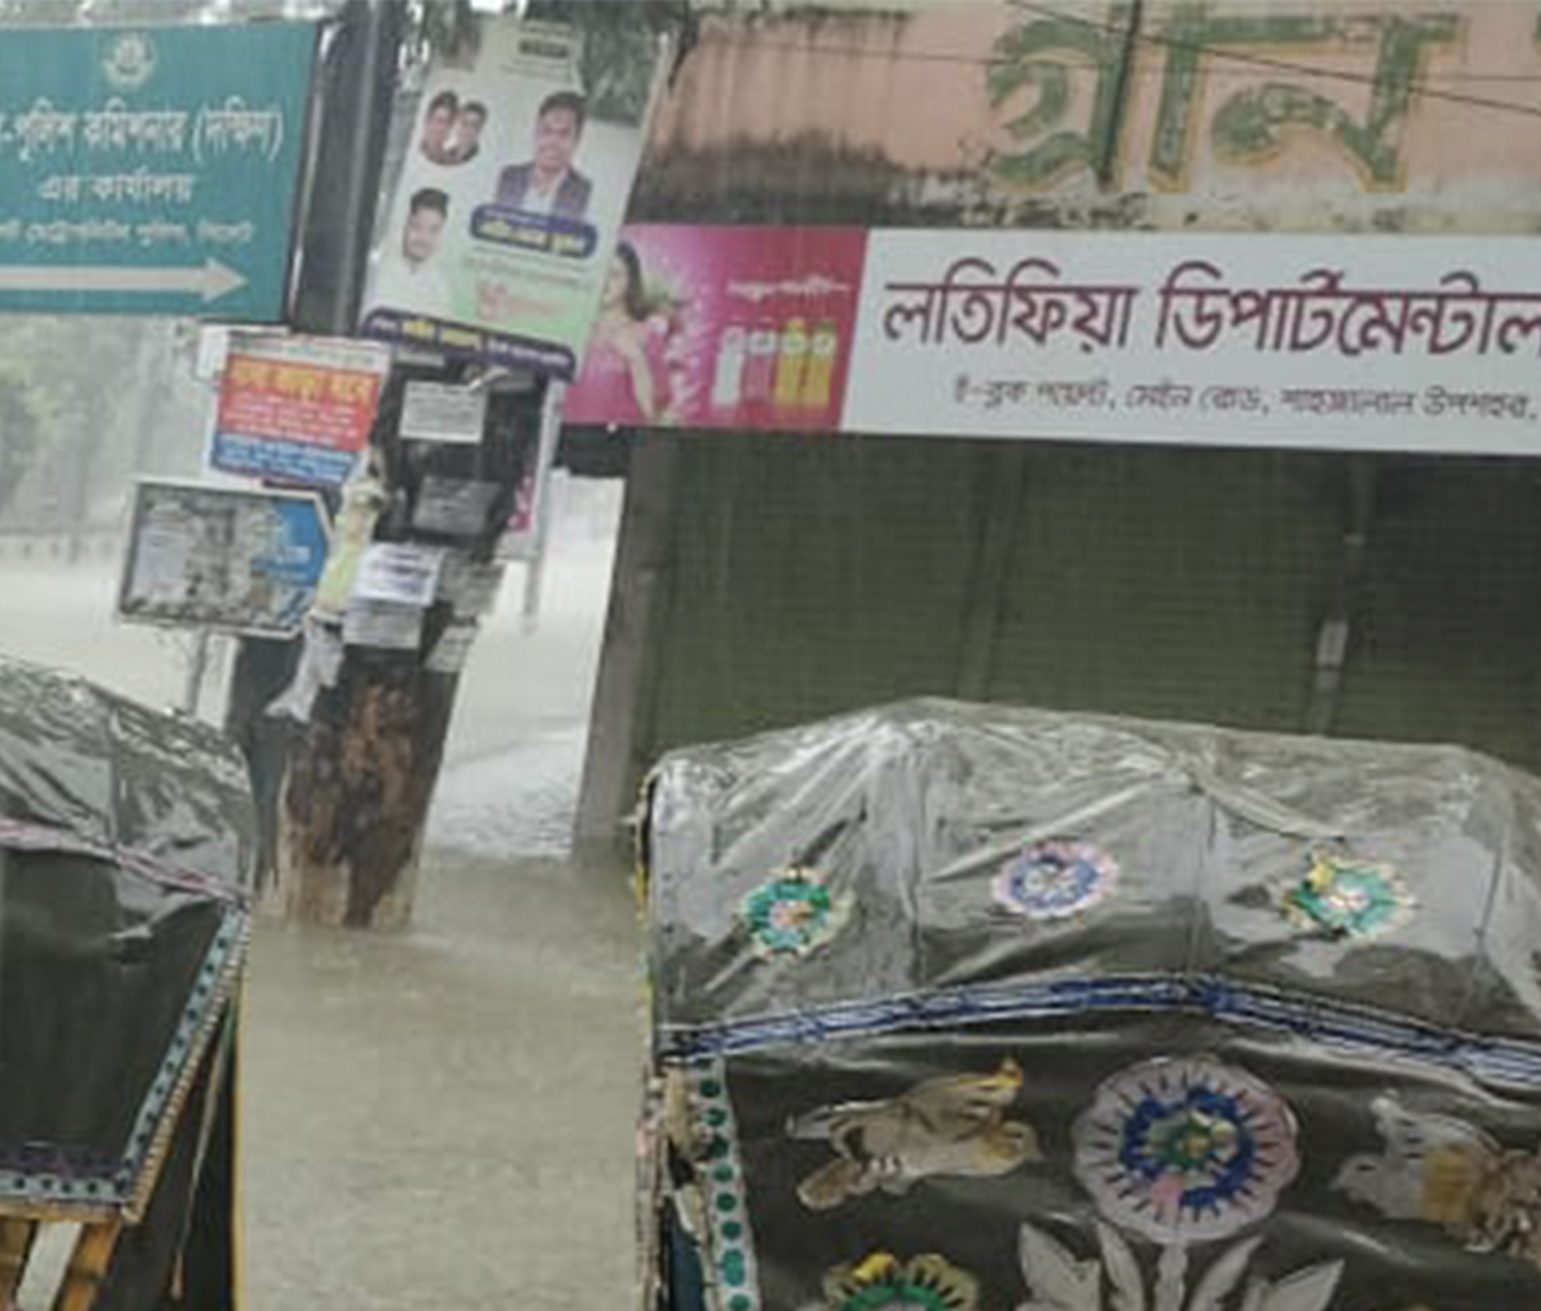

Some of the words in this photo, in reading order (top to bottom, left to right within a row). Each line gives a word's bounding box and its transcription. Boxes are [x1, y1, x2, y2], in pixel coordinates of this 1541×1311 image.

[39, 174, 78, 201] এর
[882, 258, 1138, 354] লতিফিয়া
[1153, 261, 1541, 355] ডিপার্টমেন্টাল
